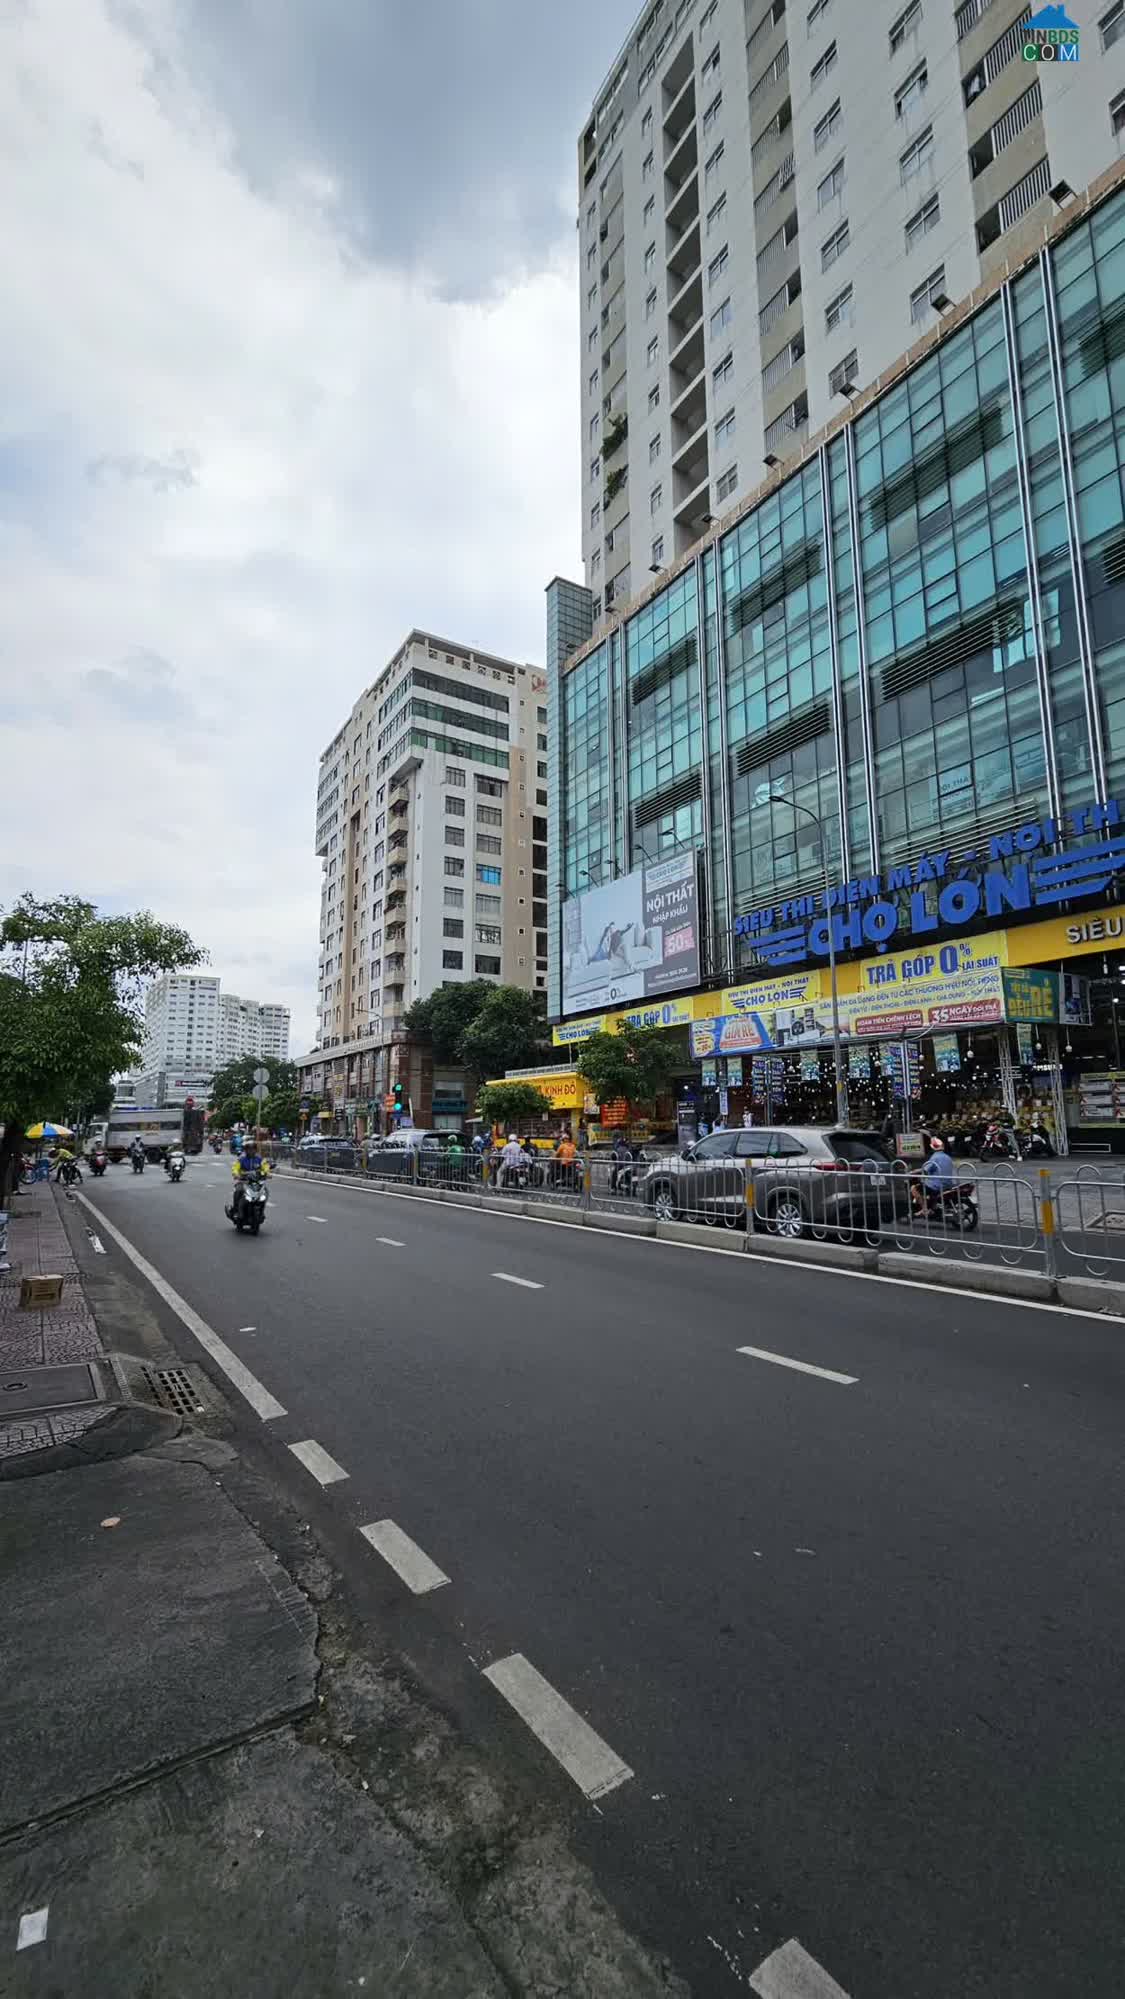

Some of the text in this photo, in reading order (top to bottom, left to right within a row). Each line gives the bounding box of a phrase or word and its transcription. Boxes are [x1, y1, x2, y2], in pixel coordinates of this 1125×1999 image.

[887, 850, 951, 891] MÁY
[990, 819, 1056, 860] NỘI
[646, 894, 665, 912] NỘI
[665, 881, 695, 906] THẤT
[809, 863, 1032, 955] CHỢ LỚN
[866, 959, 897, 985] TRẢ
[902, 953, 936, 978] GÓP
